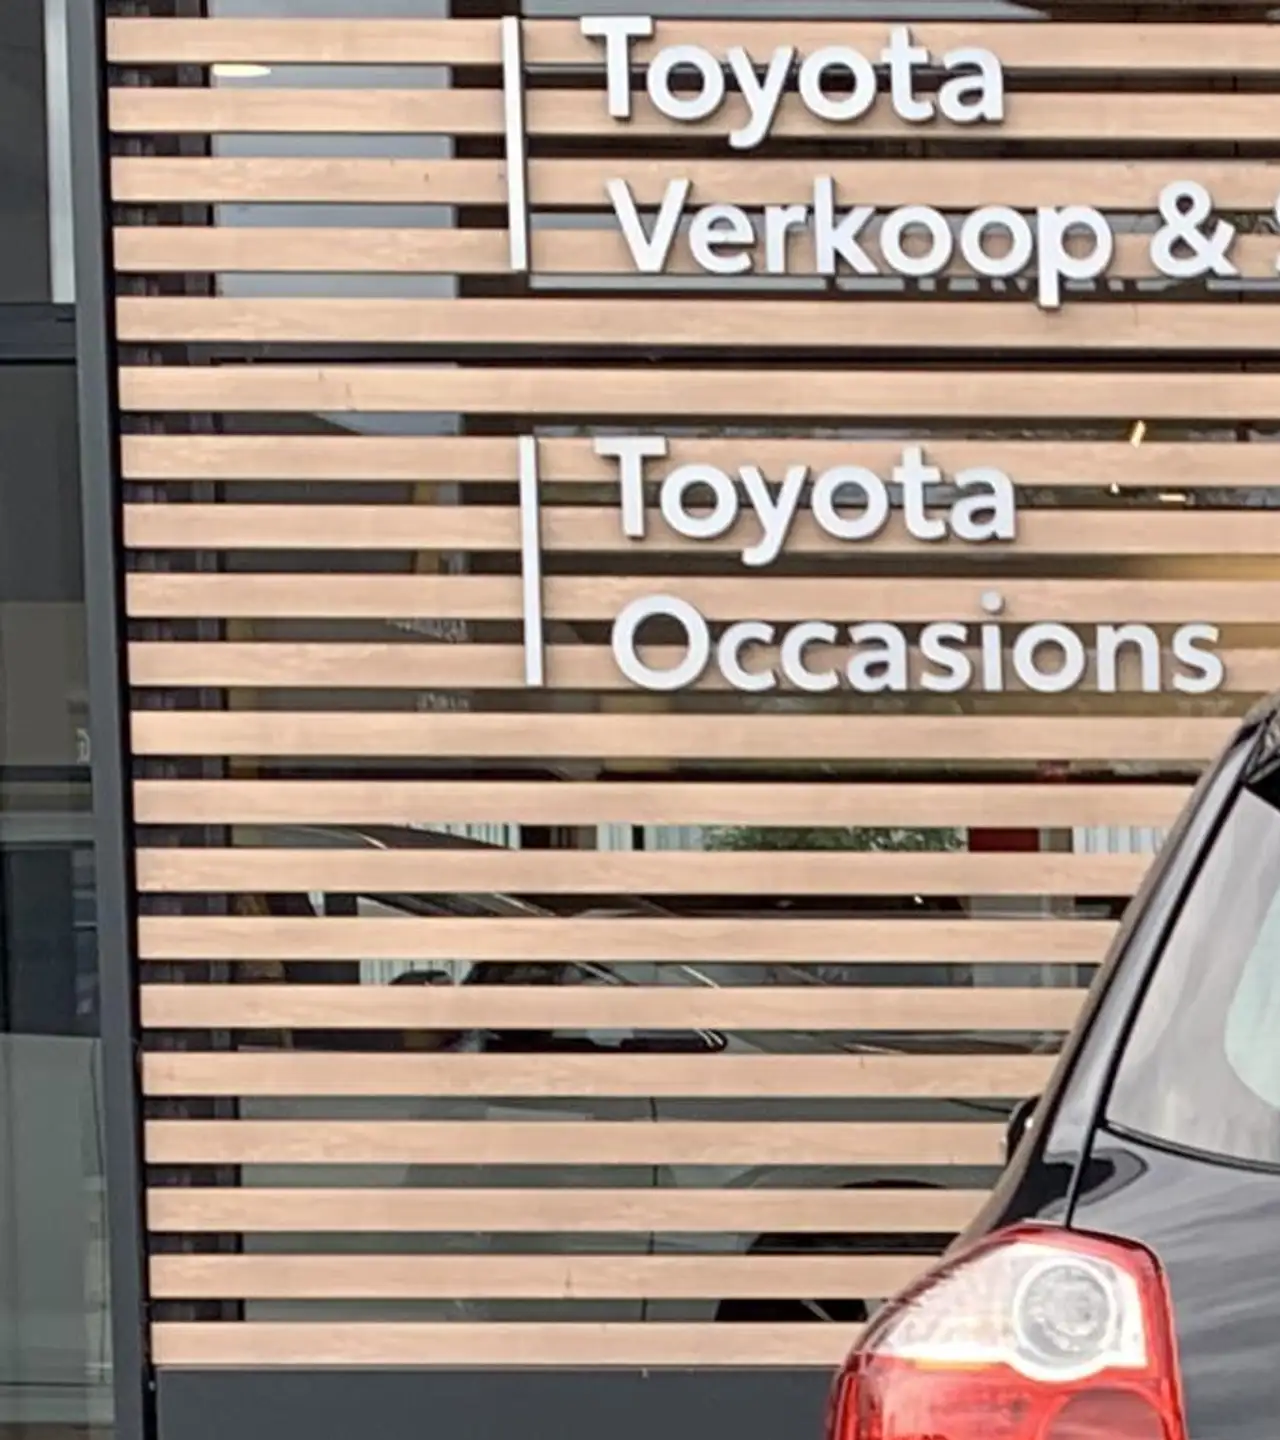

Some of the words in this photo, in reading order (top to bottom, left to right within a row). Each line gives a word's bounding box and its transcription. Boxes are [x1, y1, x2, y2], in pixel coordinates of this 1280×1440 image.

[582, 15, 1005, 147] Toyota
[606, 175, 1112, 309] Verkoop
[1150, 179, 1237, 279] &
[594, 437, 1016, 566] Toyota
[611, 591, 1224, 695] Occasions
